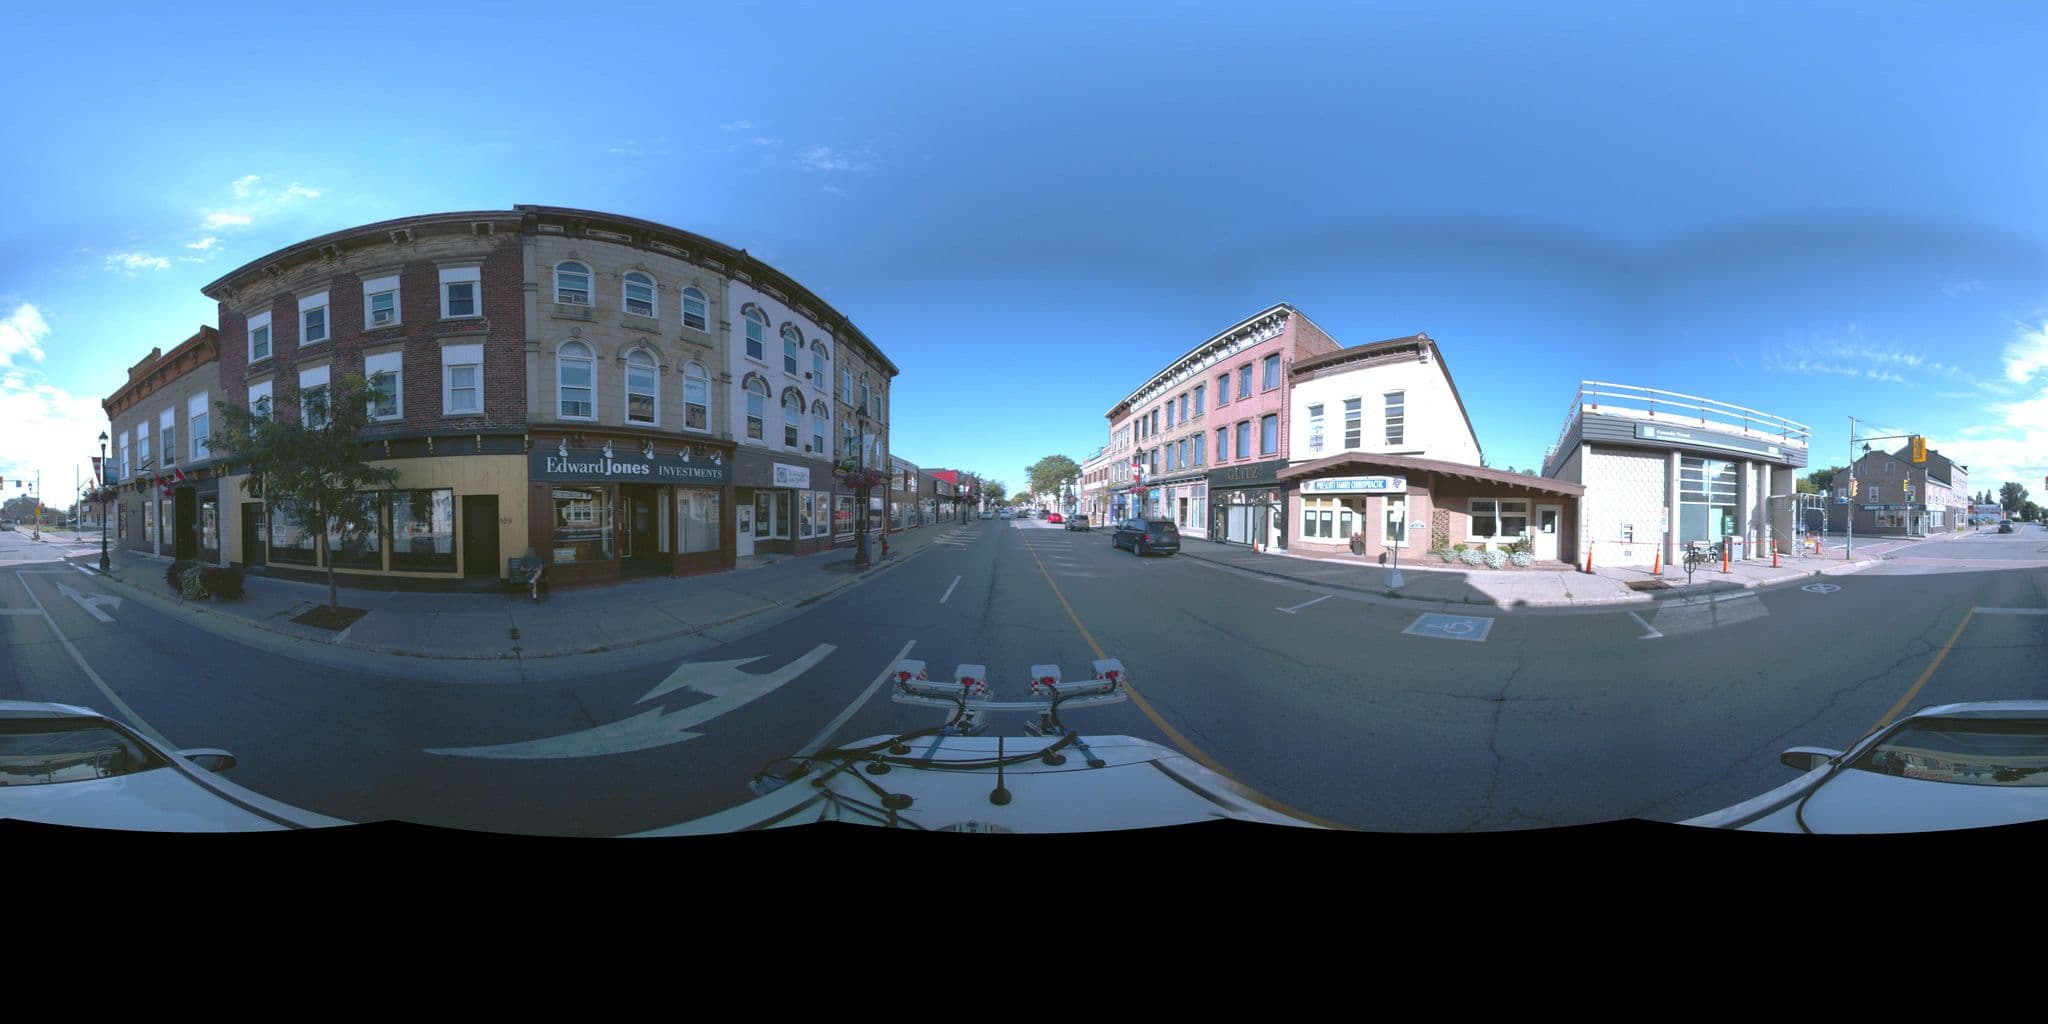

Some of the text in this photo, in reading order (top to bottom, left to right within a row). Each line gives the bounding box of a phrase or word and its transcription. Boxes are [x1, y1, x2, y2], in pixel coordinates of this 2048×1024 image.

[546, 457, 722, 479] Edward Jones INVESTMENTS
